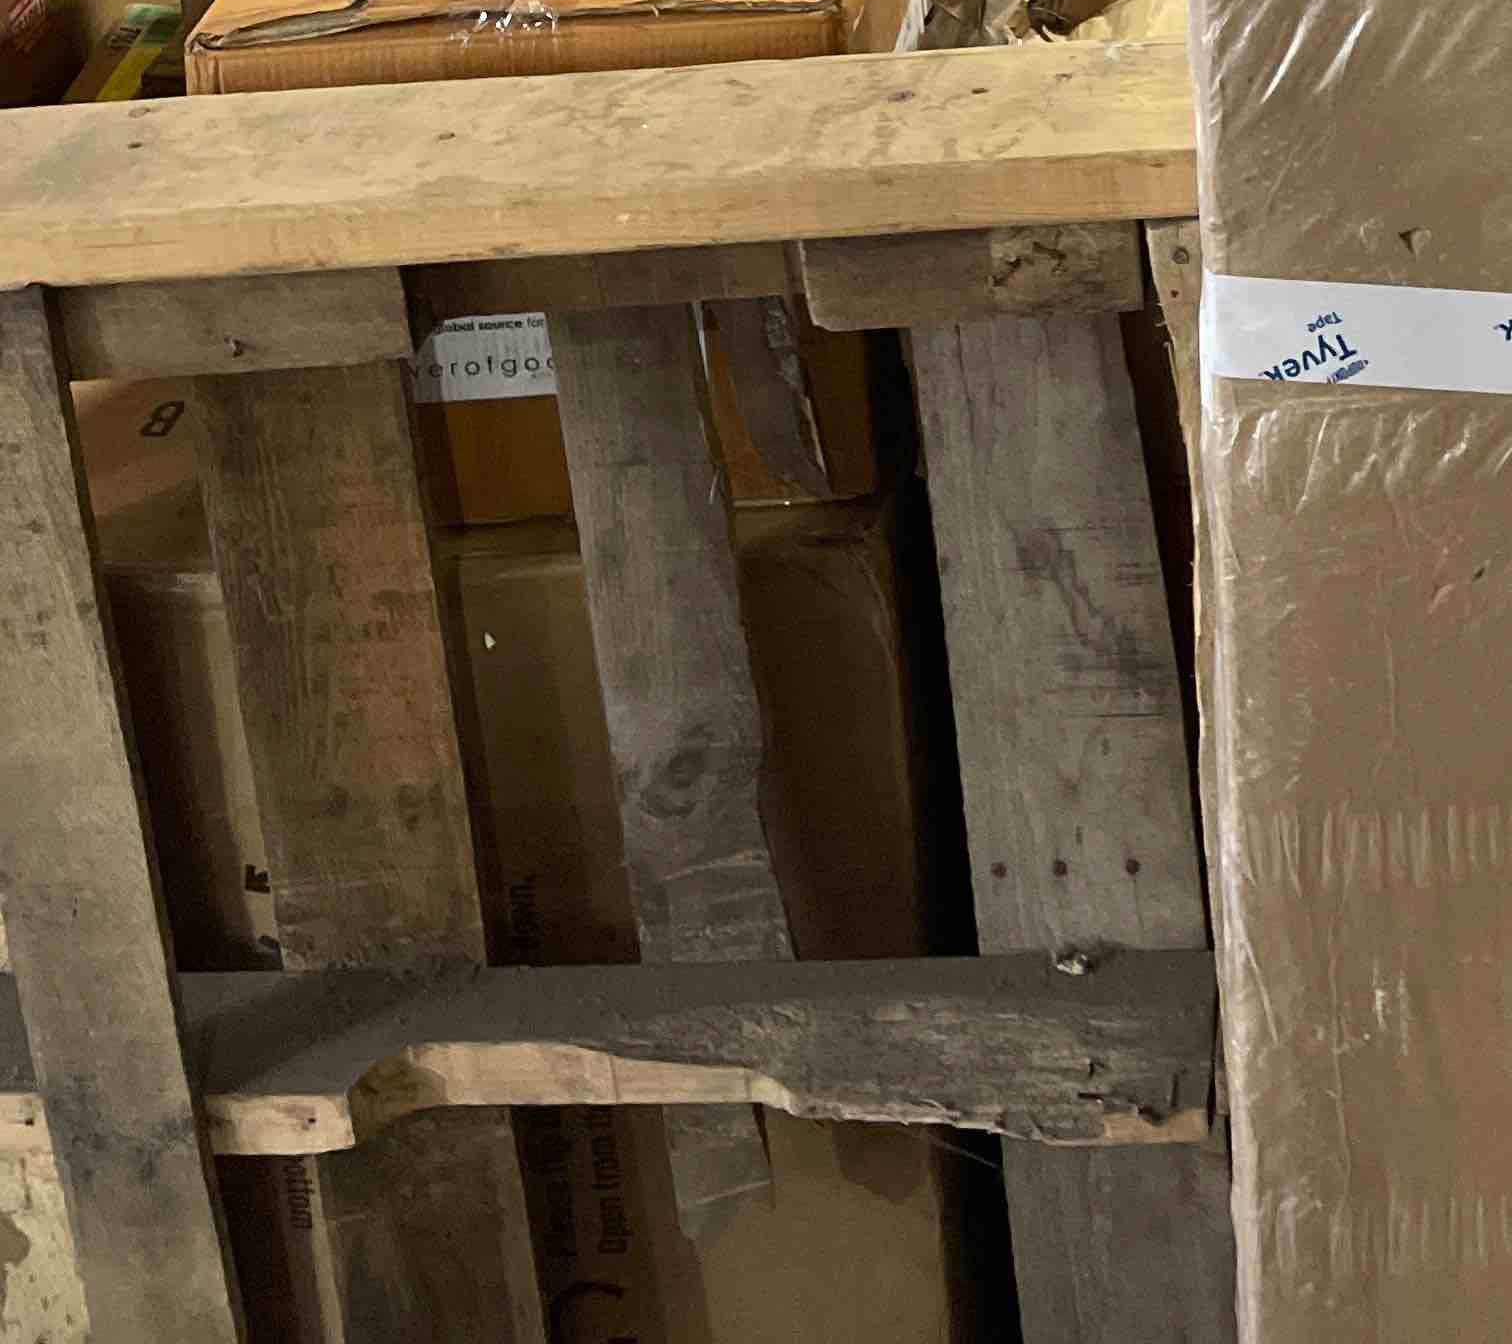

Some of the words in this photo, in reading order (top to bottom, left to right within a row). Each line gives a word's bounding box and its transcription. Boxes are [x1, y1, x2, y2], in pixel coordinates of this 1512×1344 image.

[1308, 311, 1342, 333] Tape
[1263, 334, 1357, 382] Tyvek
[280, 1155, 313, 1230] ottom
